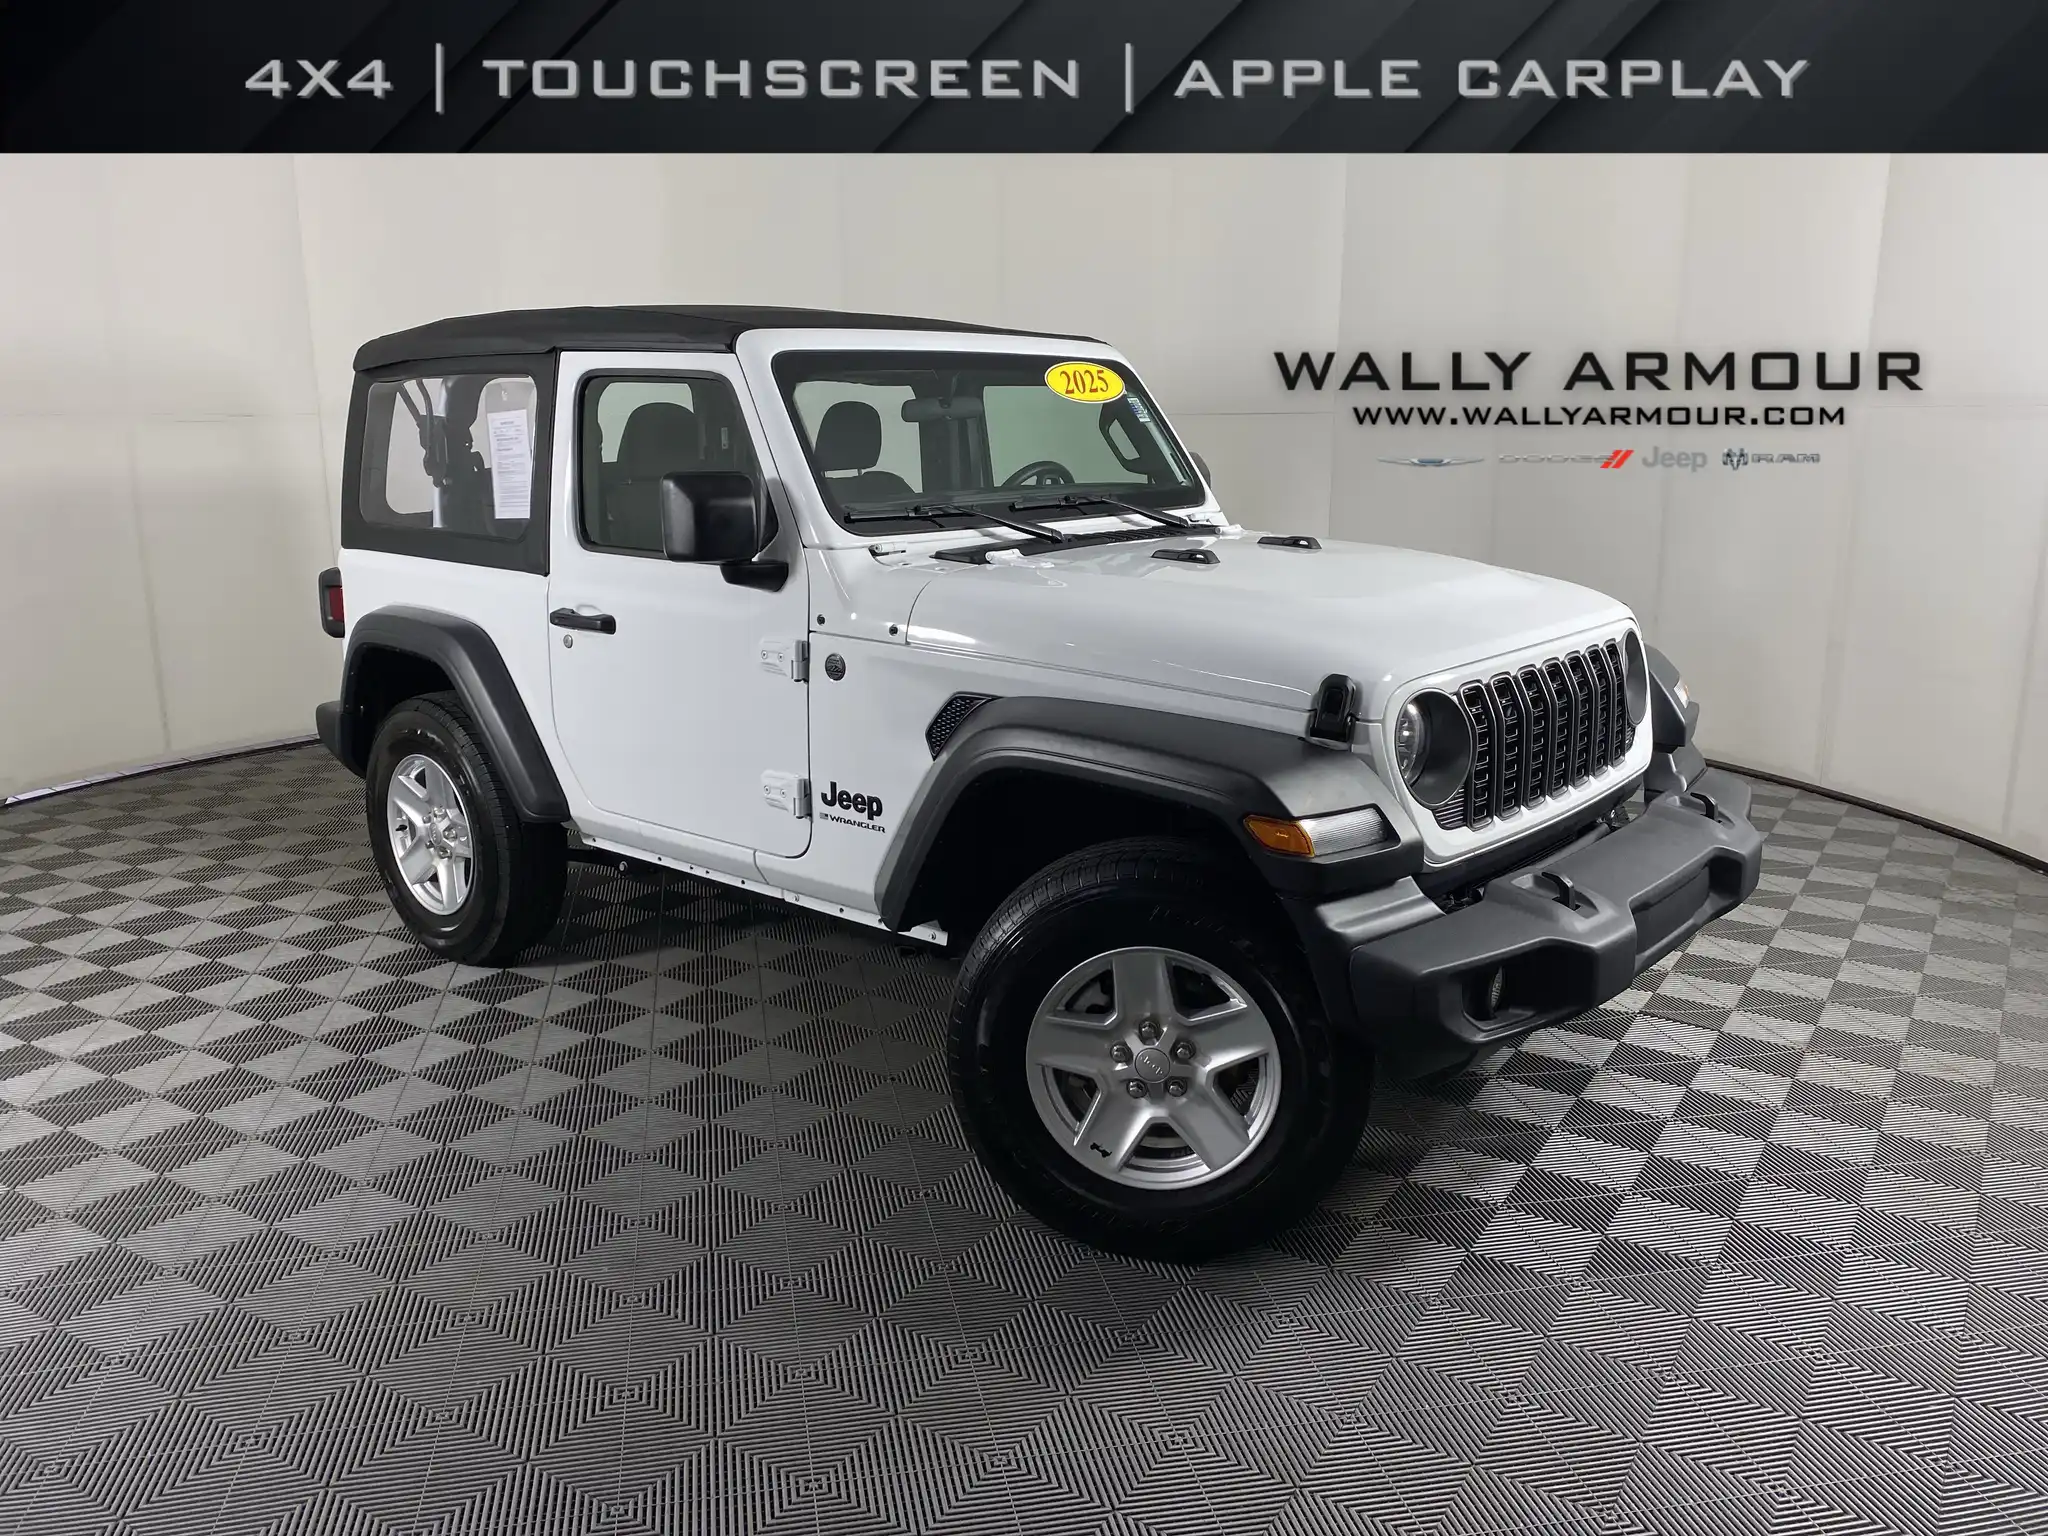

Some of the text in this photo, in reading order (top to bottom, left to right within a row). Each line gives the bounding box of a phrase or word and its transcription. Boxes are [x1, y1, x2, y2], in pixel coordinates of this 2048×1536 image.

[1059, 369, 1109, 395] 2025
[1273, 351, 1924, 391] WALLY ARMOUR
[1352, 406, 1846, 426] WWW.WALLYARMOUR.COM
[1641, 446, 1708, 473] Jeep
[1751, 453, 1821, 464] RAM
[820, 780, 883, 821] Jeep
[829, 814, 886, 834] WRANGLER
